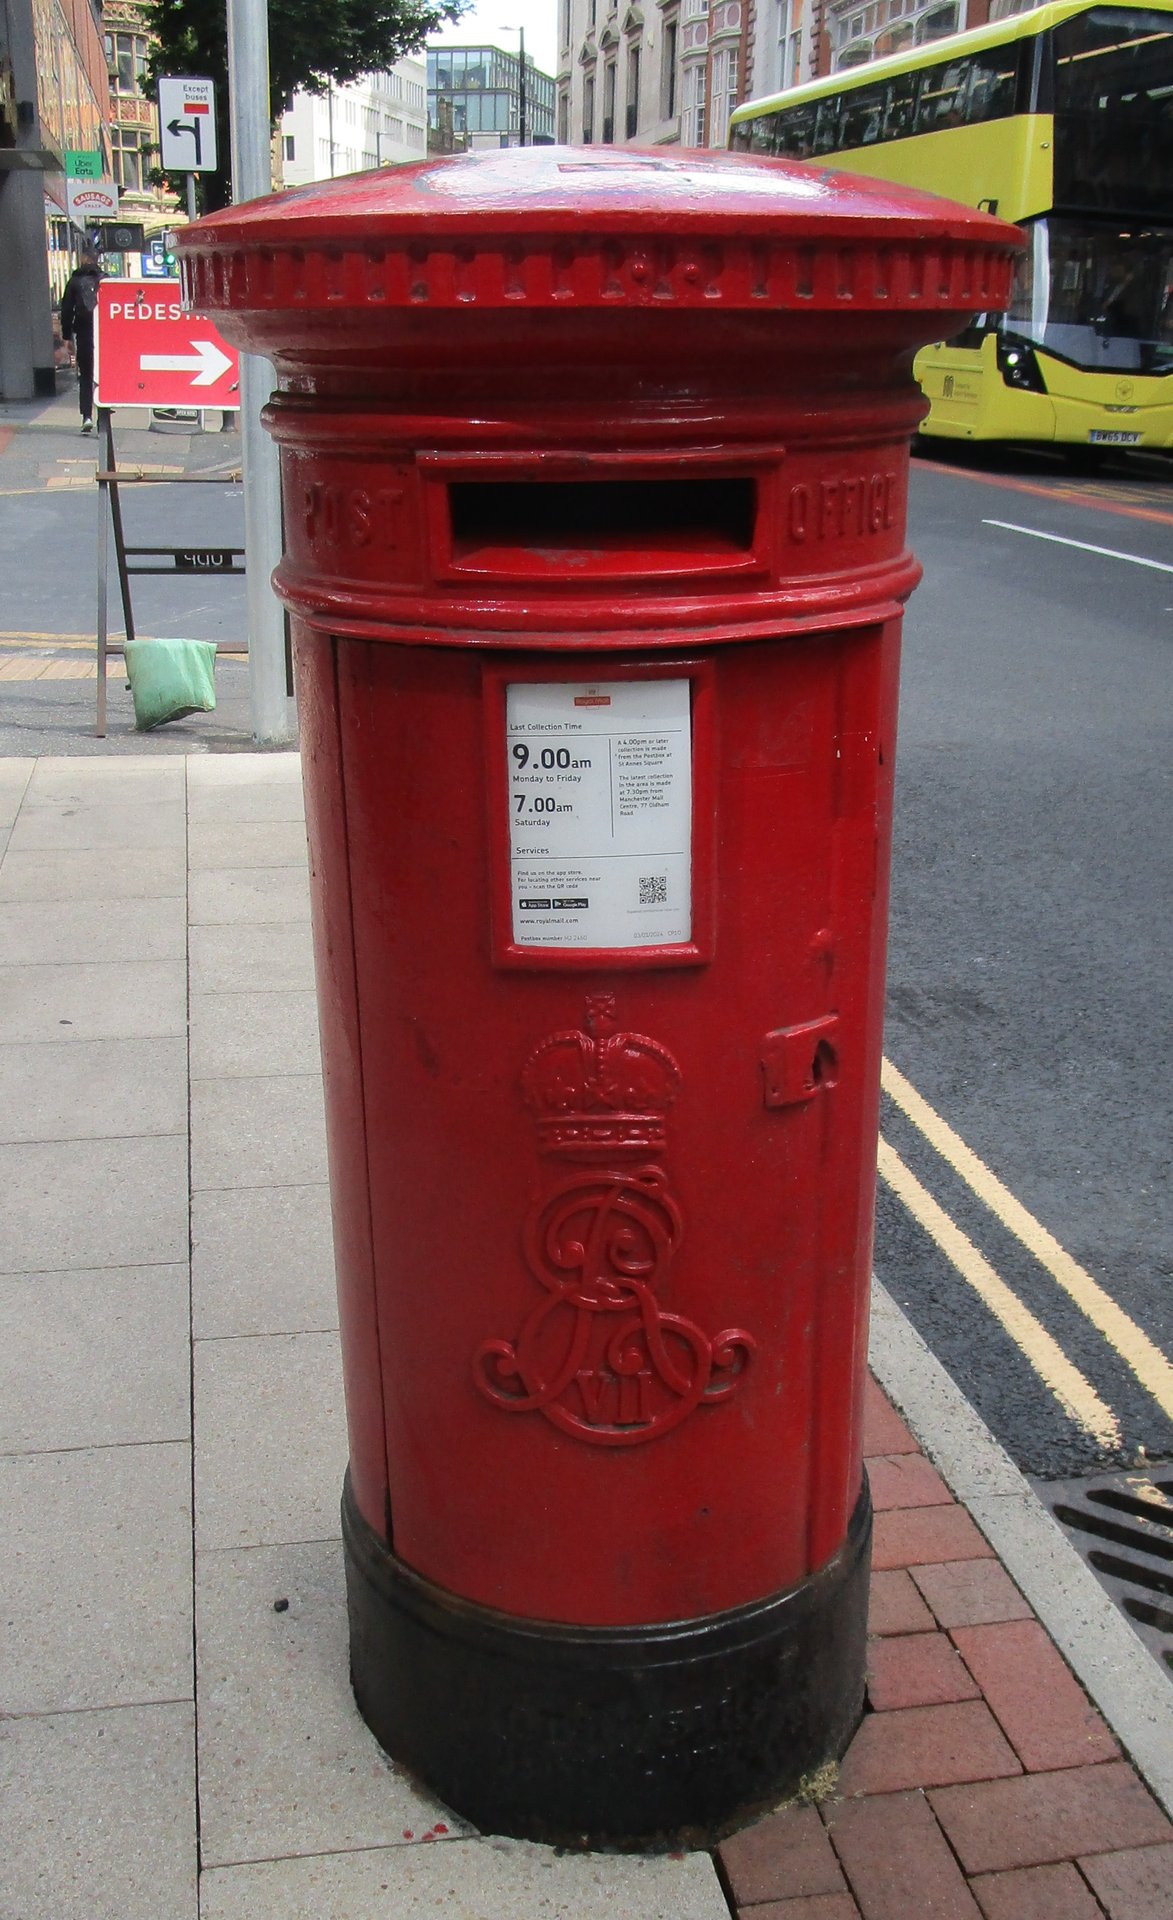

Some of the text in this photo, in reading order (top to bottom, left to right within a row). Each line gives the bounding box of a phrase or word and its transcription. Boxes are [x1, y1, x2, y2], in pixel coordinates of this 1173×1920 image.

[183, 84, 208, 93] Except
[74, 193, 111, 205] SAUSAGE
[110, 303, 208, 320] PEDES
[301, 473, 897, 552] POST OFFICE
[512, 743, 591, 769] 9.00am
[513, 775, 544, 783] Monday
[514, 795, 573, 813] 7.00am
[515, 819, 550, 827] Saturday
